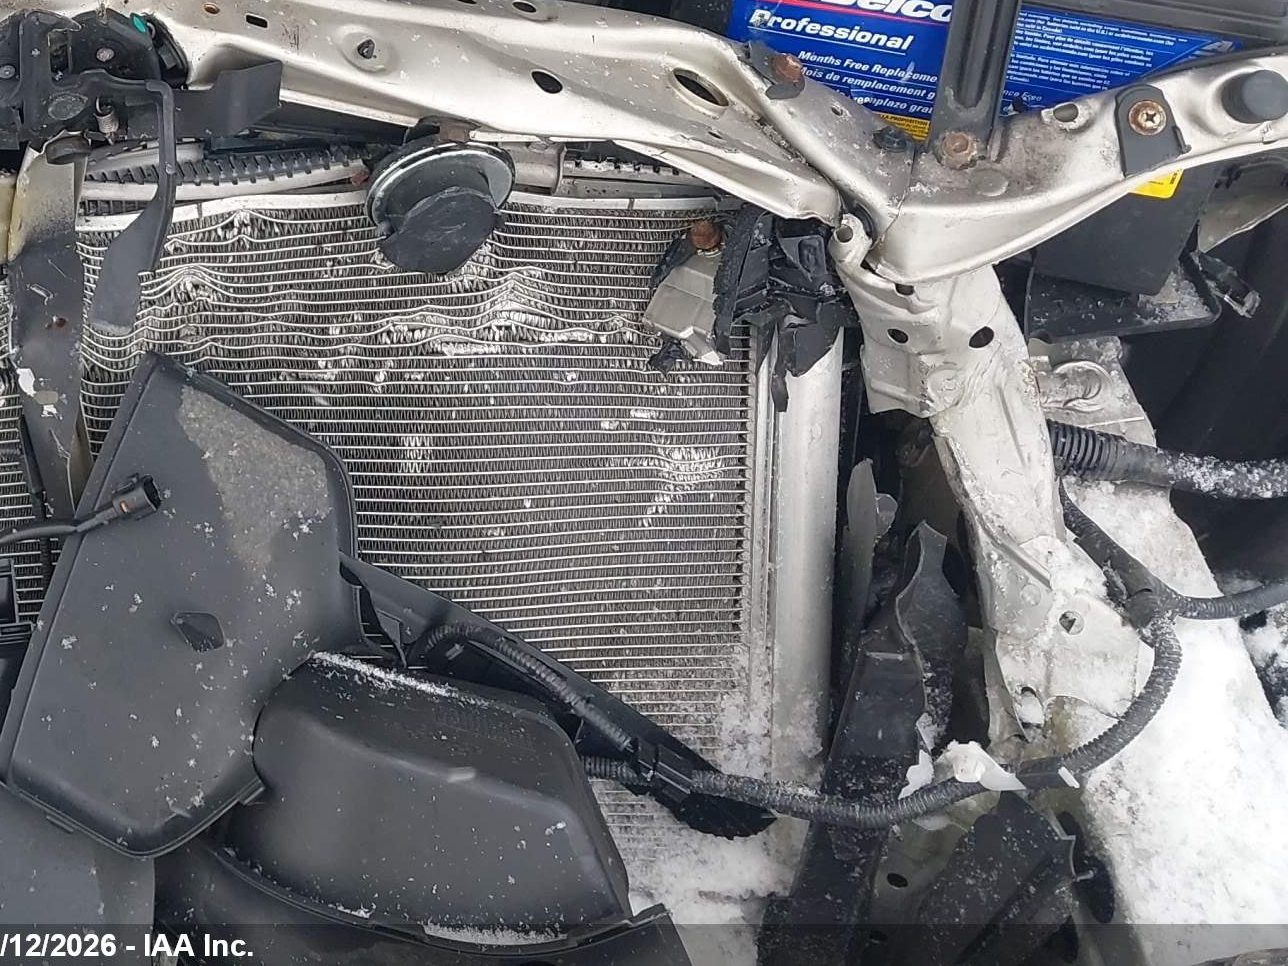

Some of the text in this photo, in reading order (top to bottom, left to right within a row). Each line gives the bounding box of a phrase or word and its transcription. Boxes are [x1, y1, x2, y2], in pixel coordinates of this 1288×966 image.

[749, 9, 914, 50] Professional
[798, 51, 842, 66] Months
[843, 58, 870, 72] Free
[825, 71, 840, 82] de
[842, 76, 926, 97] remplacement
